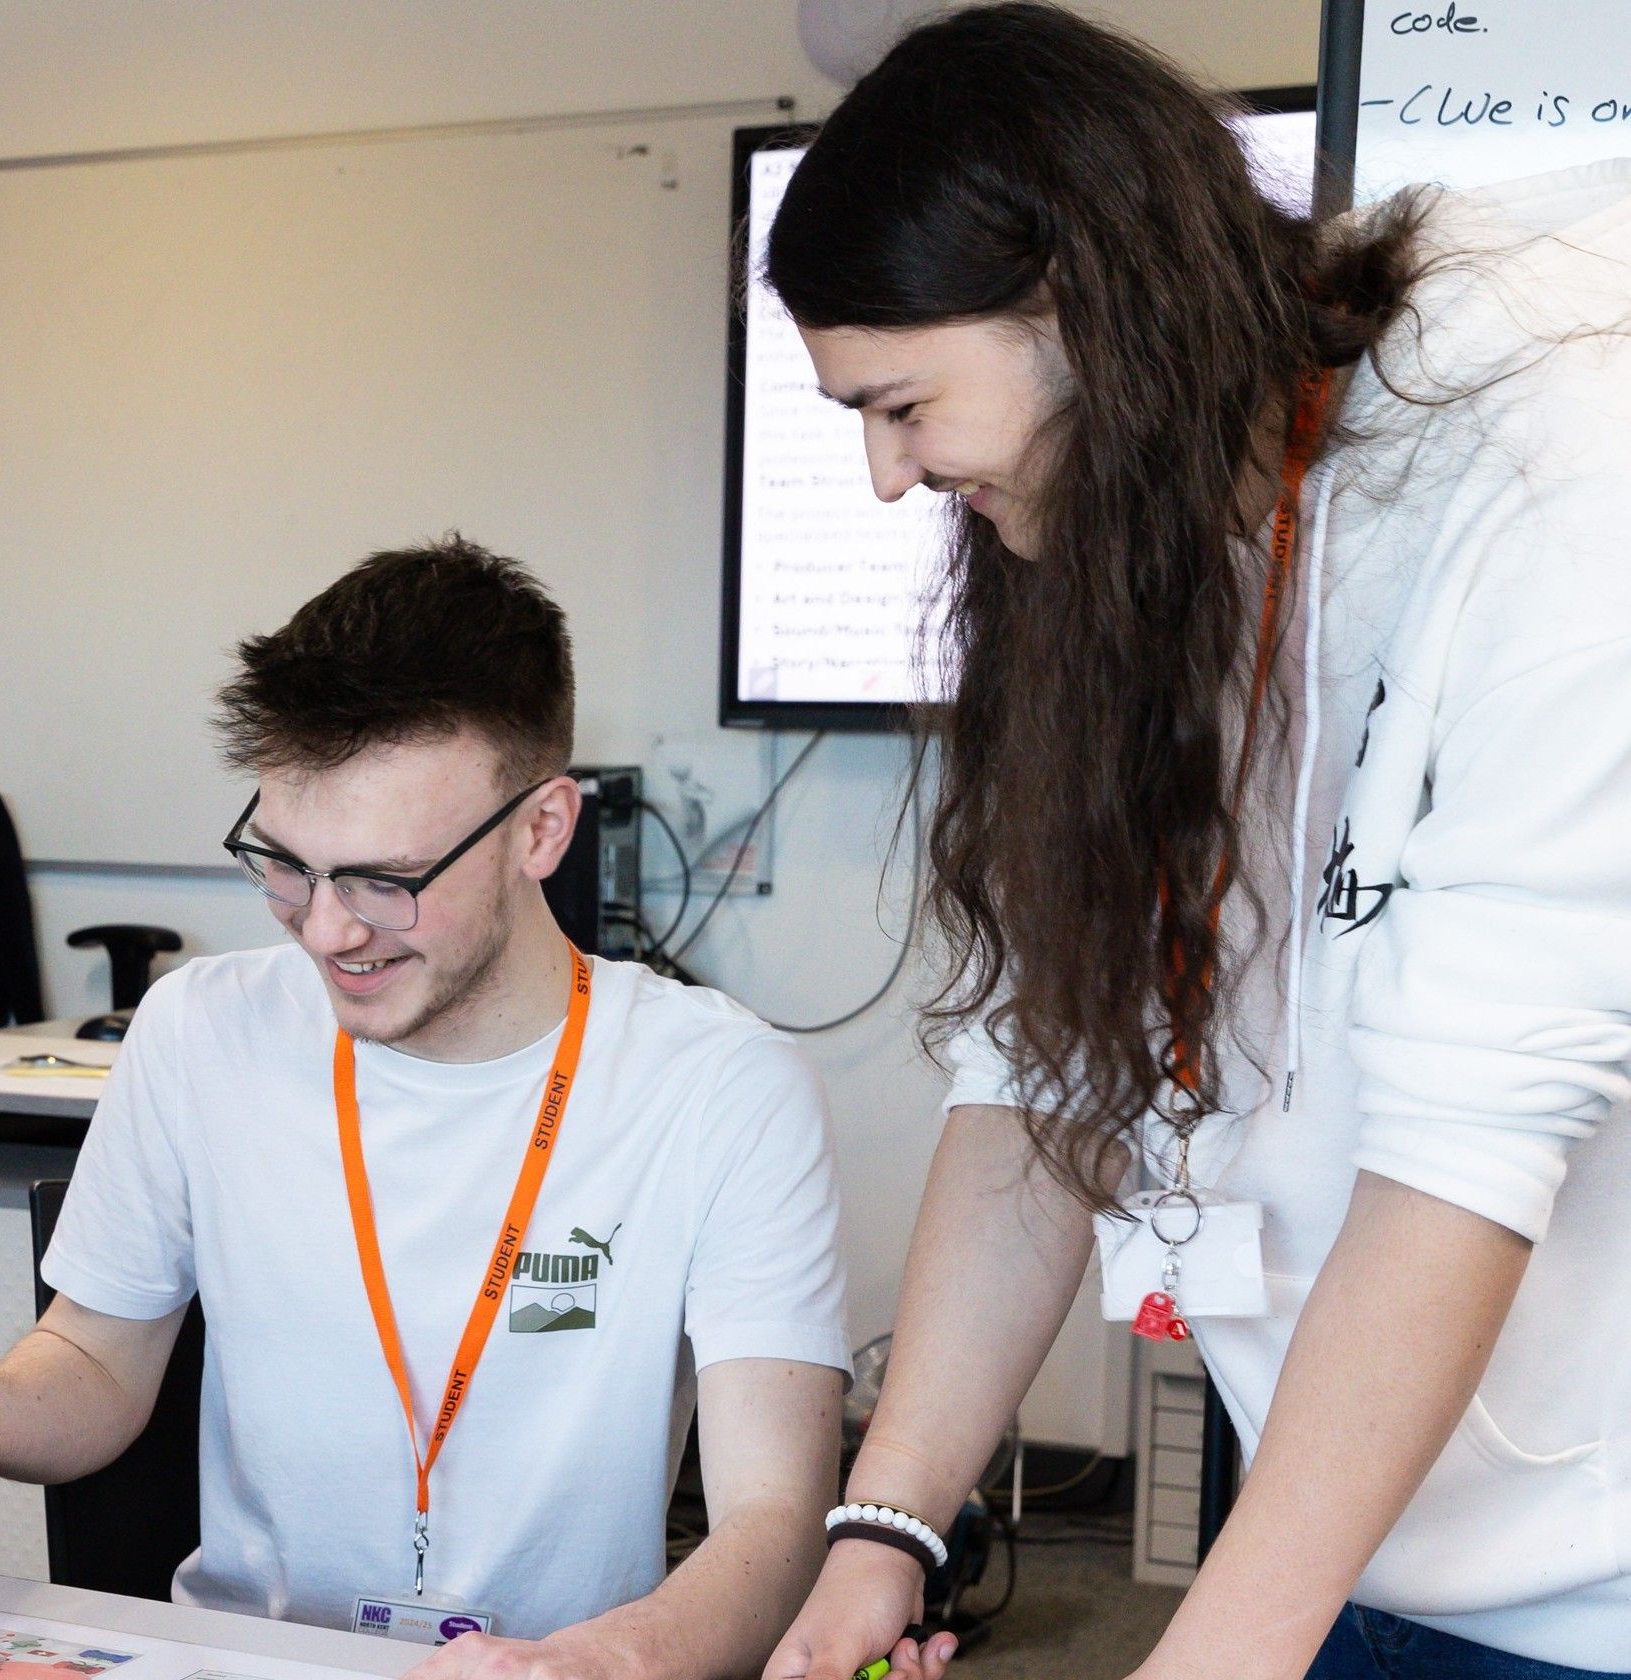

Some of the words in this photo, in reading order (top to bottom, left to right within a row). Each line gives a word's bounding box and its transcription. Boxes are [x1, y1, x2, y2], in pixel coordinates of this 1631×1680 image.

[1390, 1, 1488, 35] code.
[534, 1069, 569, 1151] STUDENT
[483, 1223, 520, 1301] STUDENT
[512, 1251, 599, 1283] PUMA
[434, 1368, 468, 1442] STUDENT
[361, 1603, 392, 1624] NKC
[399, 1617, 433, 1631] 2024/25
[448, 1620, 474, 1630] Student
